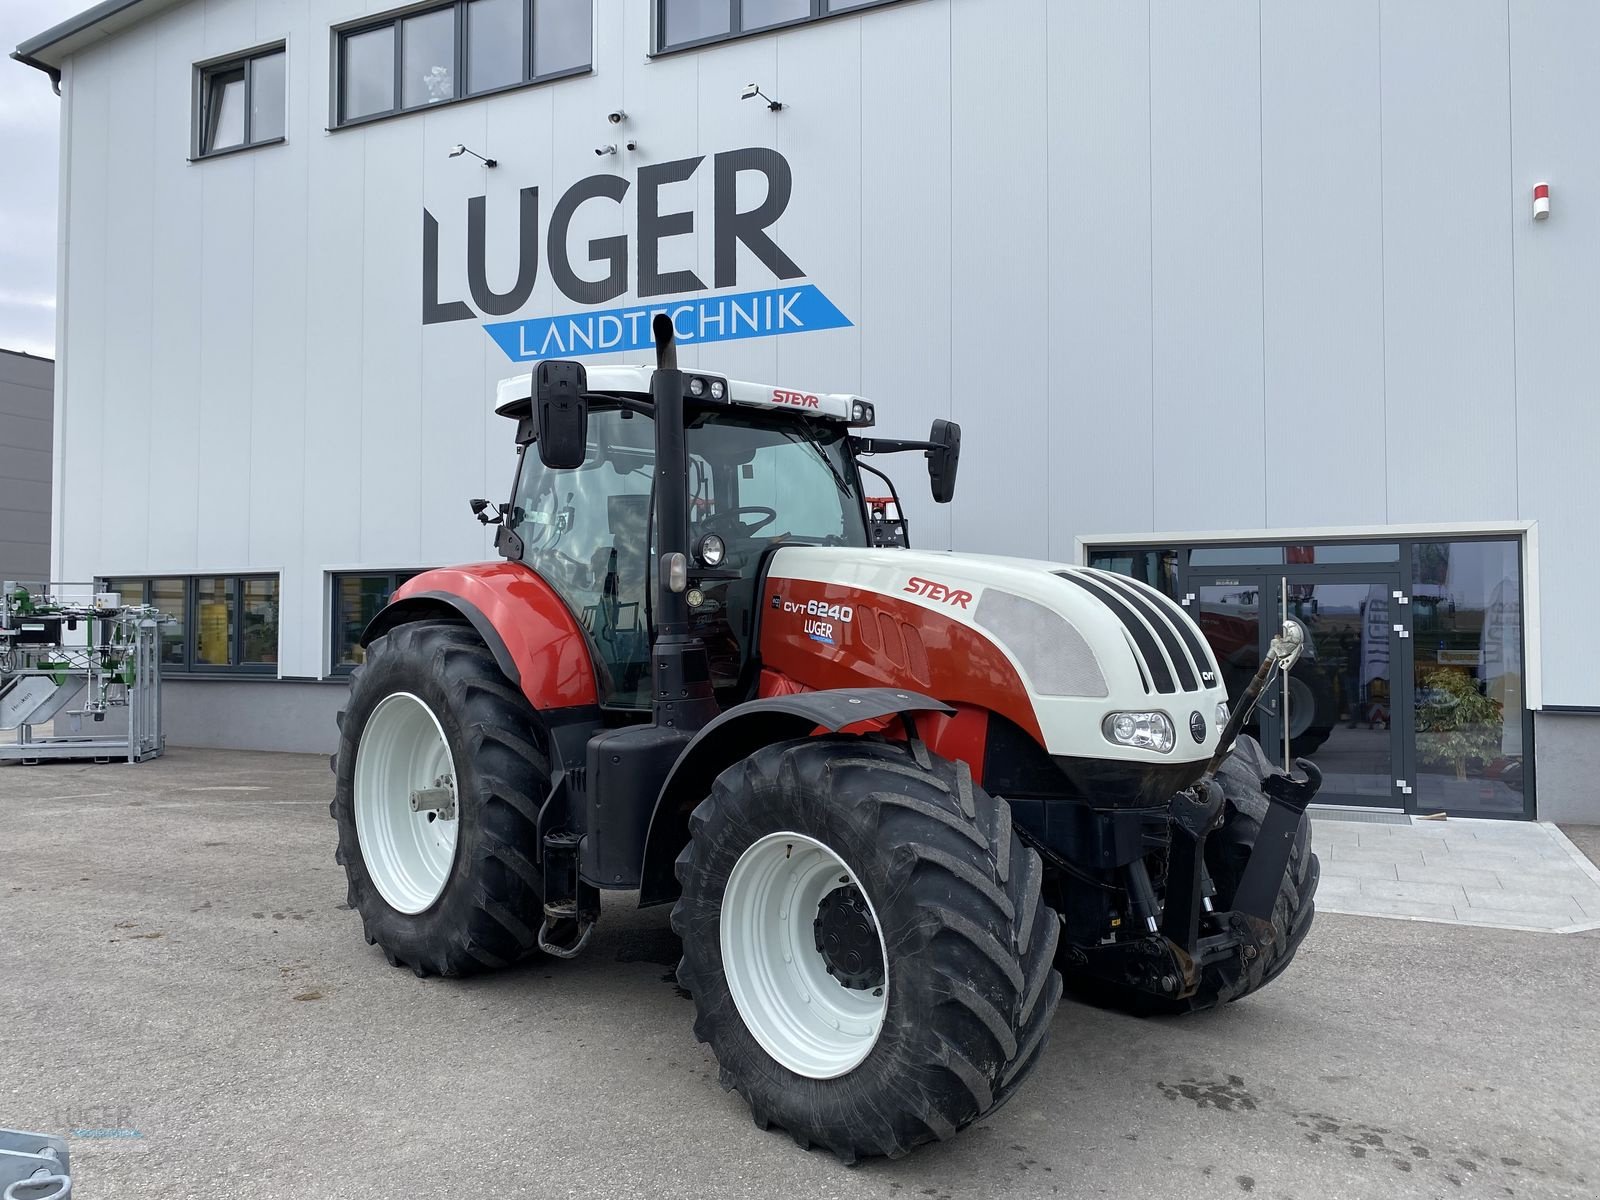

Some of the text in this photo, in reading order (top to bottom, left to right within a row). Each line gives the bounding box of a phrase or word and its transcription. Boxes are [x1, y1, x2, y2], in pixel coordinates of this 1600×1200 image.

[423, 147, 807, 325] LUGER
[772, 390, 819, 408] STEYR
[903, 577, 972, 609] STEYR
[804, 620, 832, 638] LUGER
